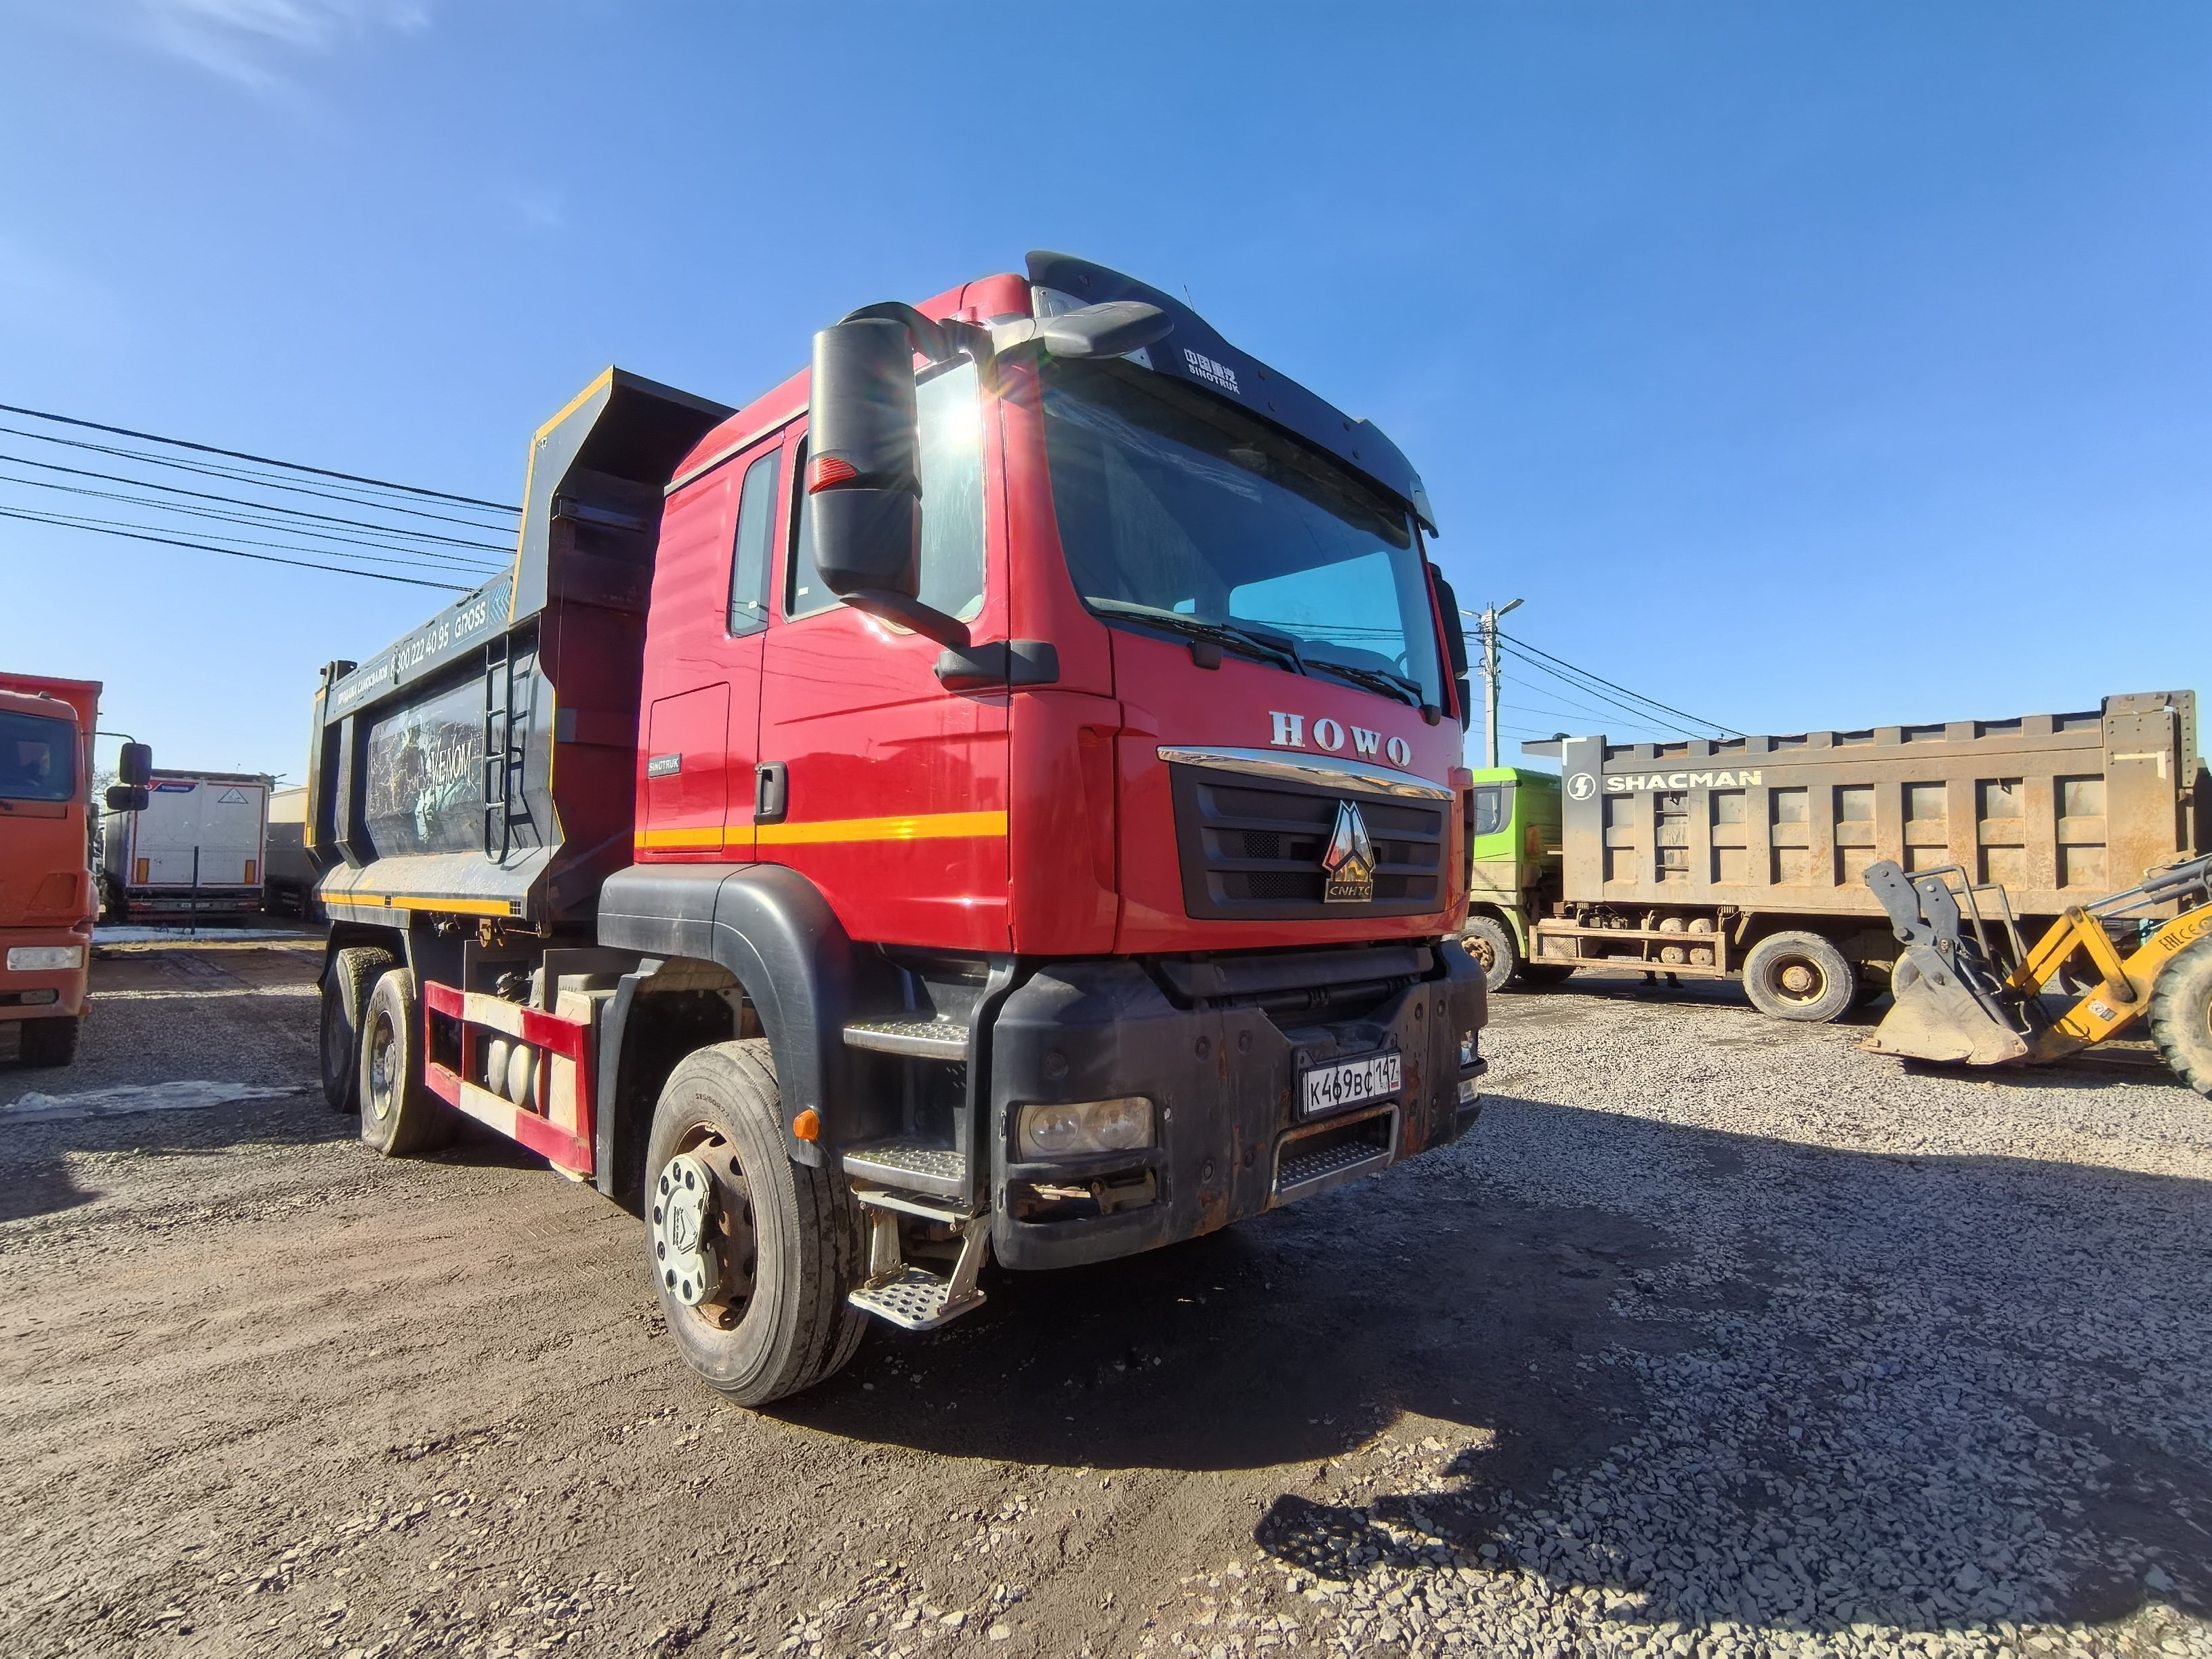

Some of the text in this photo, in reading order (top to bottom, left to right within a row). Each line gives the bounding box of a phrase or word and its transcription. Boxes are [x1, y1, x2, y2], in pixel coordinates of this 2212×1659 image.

[1183, 348, 1237, 385] 中国重汽
[1188, 364, 1240, 394] SINOTRUK
[411, 638, 424, 665] 222
[426, 630, 437, 656] 40
[438, 621, 449, 649] 95
[454, 601, 486, 638] GROSS
[1268, 710, 1411, 767] HOWO
[649, 758, 679, 771] SINOTRUK
[1607, 770, 1762, 792] SHACMAN
[1330, 886, 1370, 895] CNHTC
[1376, 1059, 1396, 1082] 147
